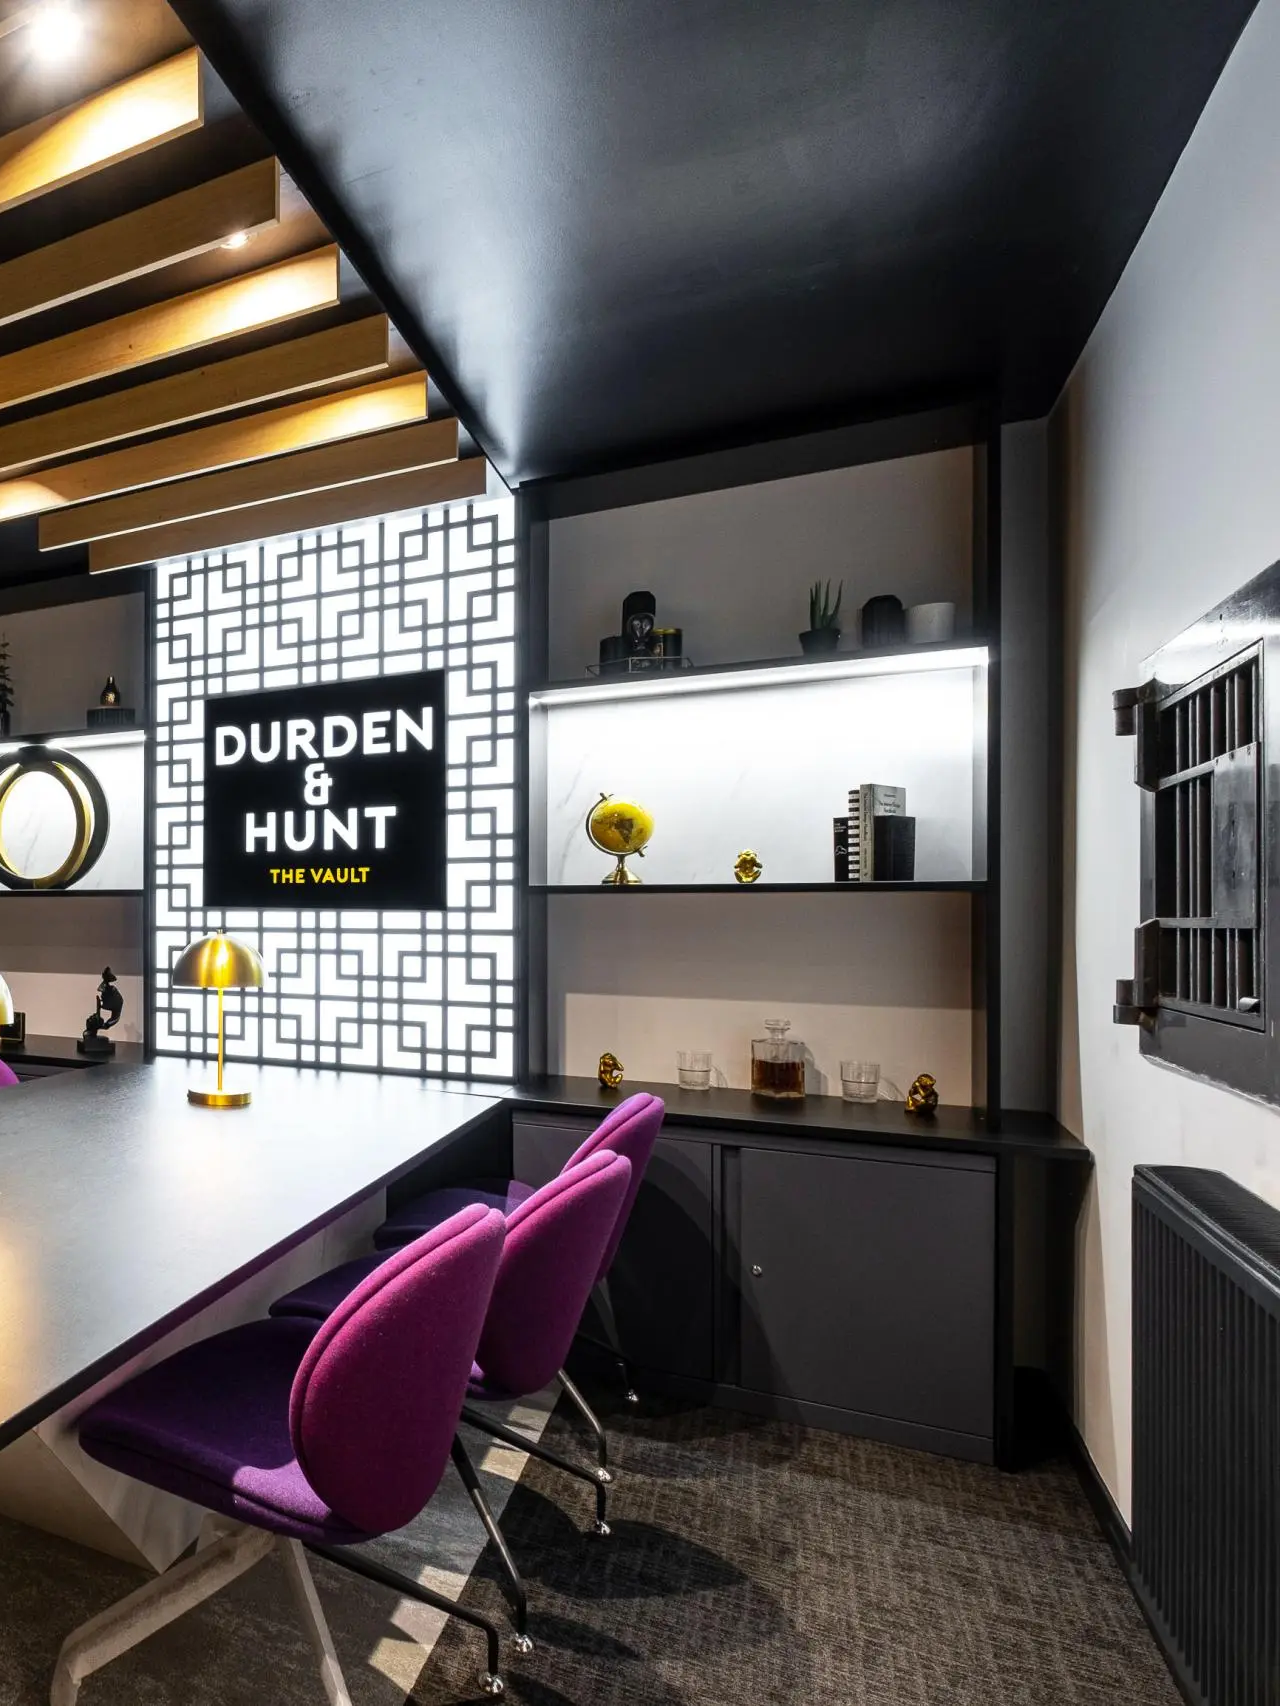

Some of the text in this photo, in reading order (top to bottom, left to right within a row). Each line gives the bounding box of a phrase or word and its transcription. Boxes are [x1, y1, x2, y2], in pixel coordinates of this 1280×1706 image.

[215, 706, 434, 767] DURDEN
[303, 761, 334, 807] &
[245, 805, 398, 853] HUNT
[269, 866, 371, 884] THE VAULT
